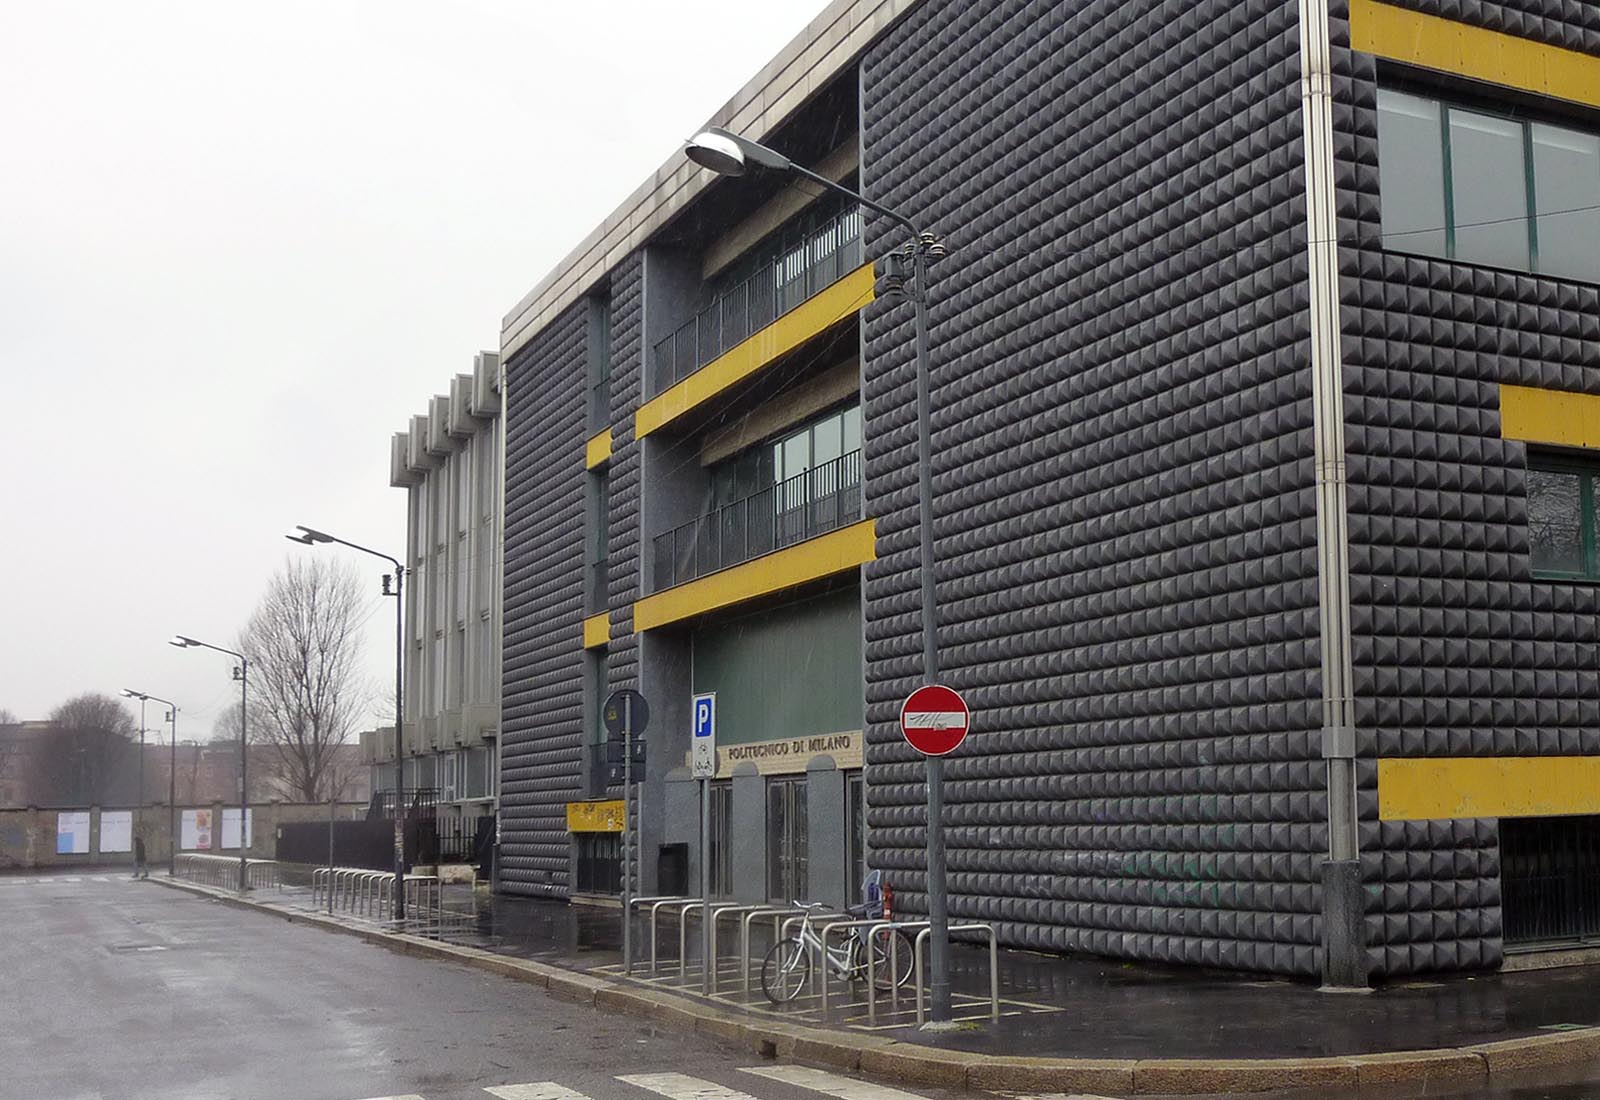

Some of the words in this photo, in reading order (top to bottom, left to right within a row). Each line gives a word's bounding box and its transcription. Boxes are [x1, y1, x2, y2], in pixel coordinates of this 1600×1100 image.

[698, 704, 708, 733] P
[729, 742, 789, 760] POLITECNICO
[792, 741, 805, 754] DI
[808, 735, 850, 752] MILANO
